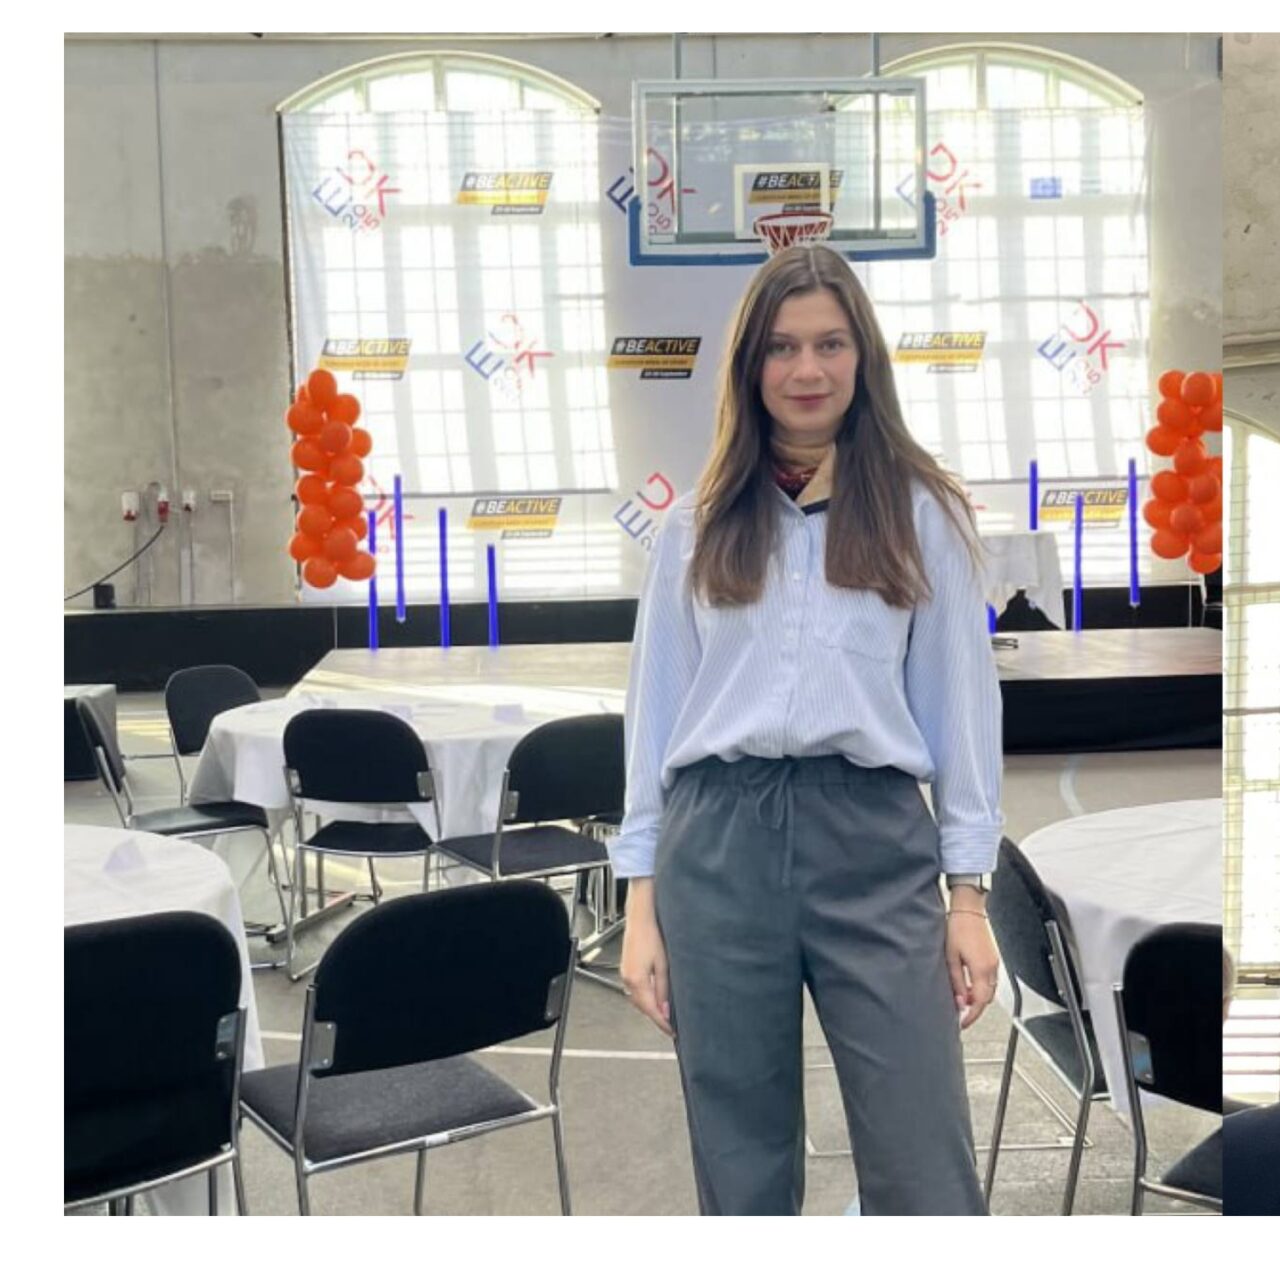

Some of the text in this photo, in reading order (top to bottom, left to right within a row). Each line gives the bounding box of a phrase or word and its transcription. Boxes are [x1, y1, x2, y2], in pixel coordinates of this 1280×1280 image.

[327, 340, 409, 355] #BEACTIVE
[615, 339, 697, 353] #BEACTIVE
[901, 333, 982, 348] #BEACTIVE
[475, 499, 558, 514] #BEACTIVE
